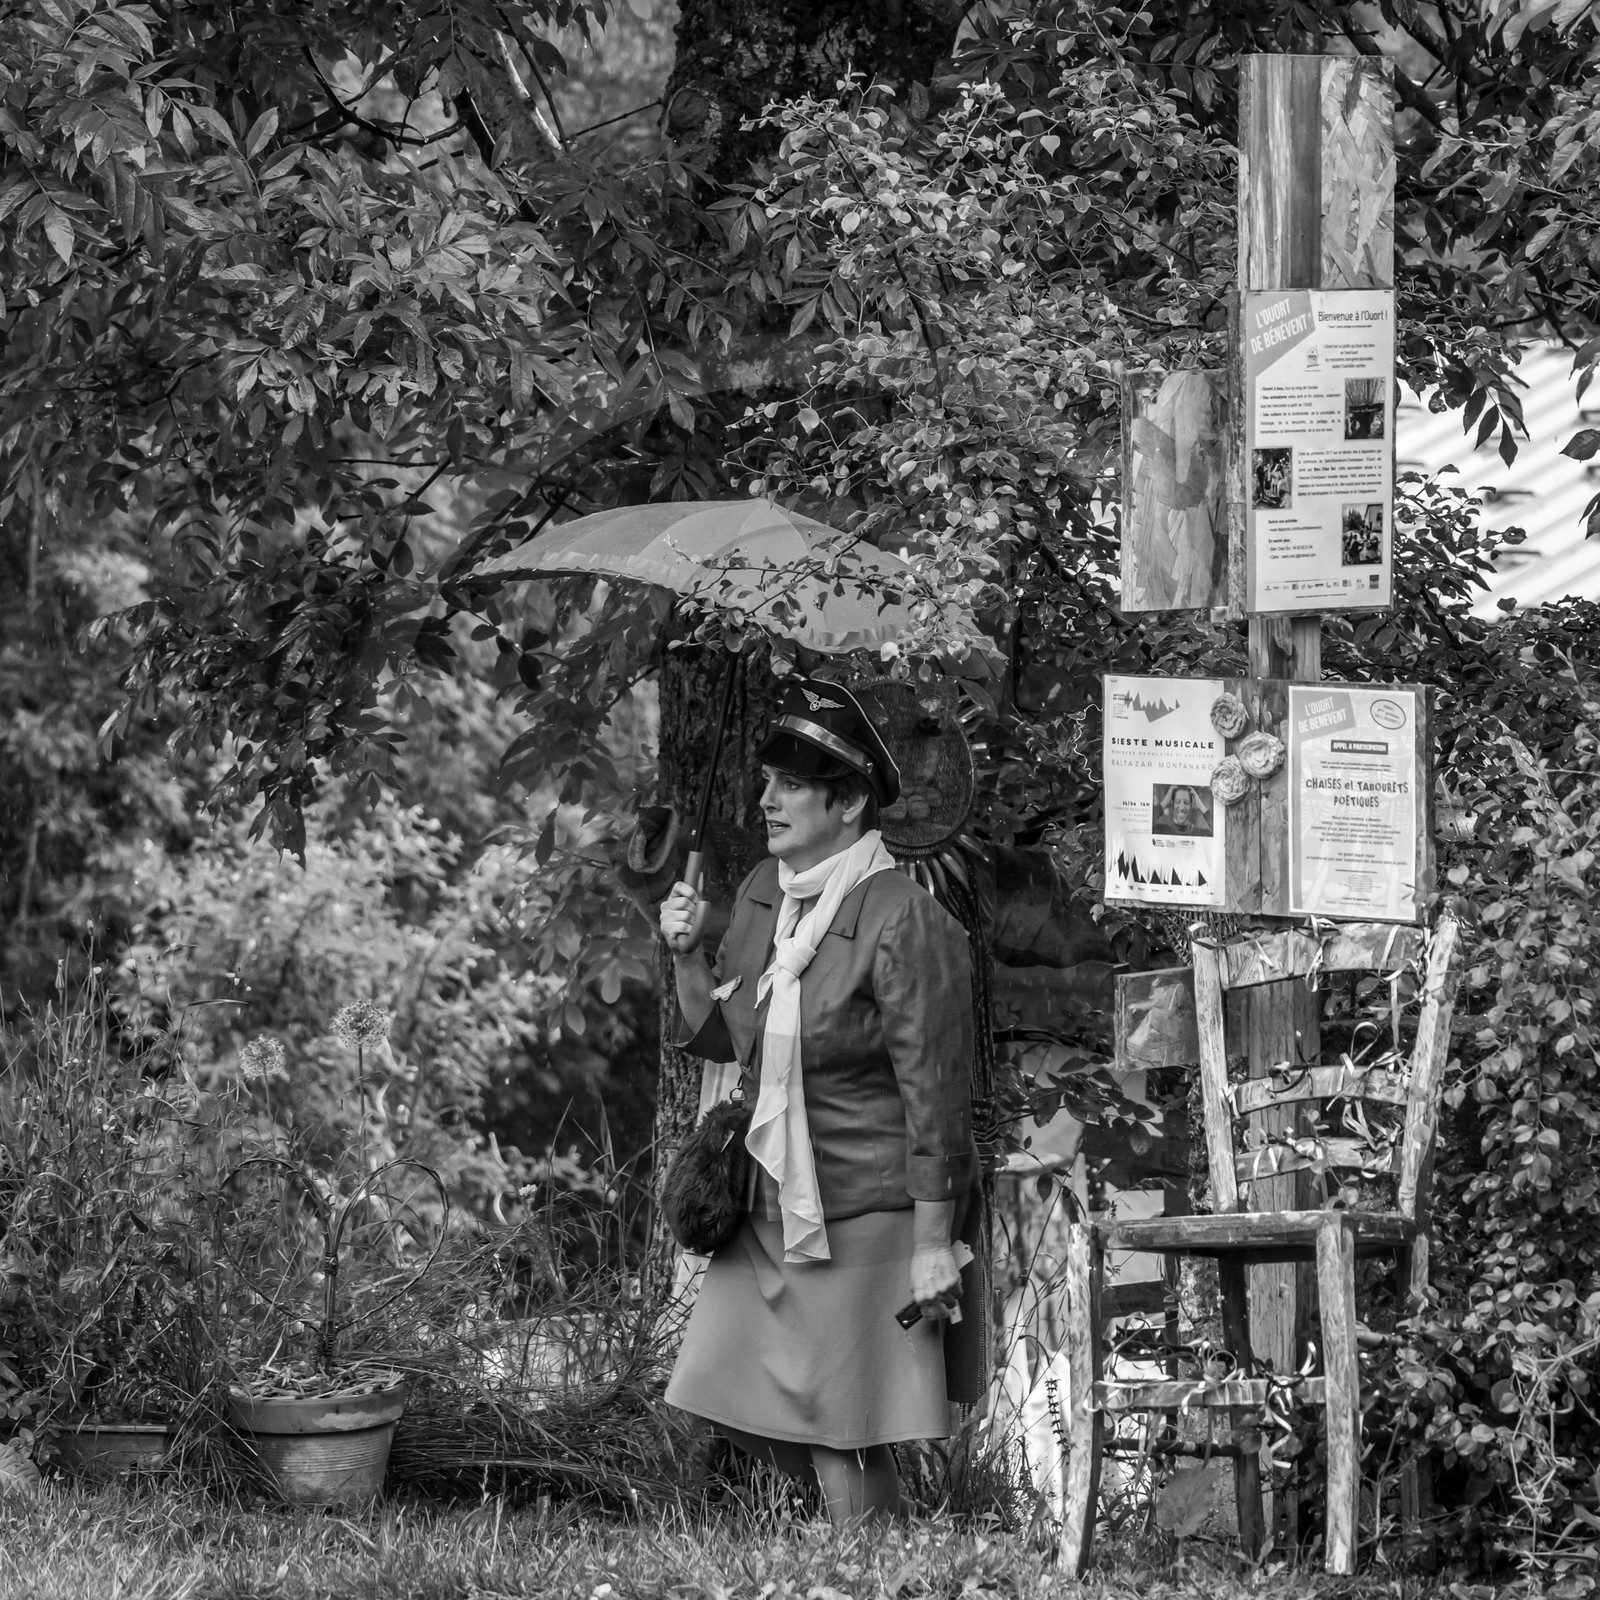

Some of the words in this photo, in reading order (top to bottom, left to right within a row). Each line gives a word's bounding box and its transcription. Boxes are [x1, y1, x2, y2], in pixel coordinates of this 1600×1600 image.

[1255, 298, 1290, 328] L'OUORT
[1318, 311, 1354, 322] Bienvenue
[1354, 310, 1360, 321] à
[1361, 310, 1384, 321] l'Ouort
[1250, 335, 1264, 354] DE
[1304, 697, 1334, 716] L'OUORT
[1298, 720, 1309, 733] DE
[1111, 737, 1148, 747] SIESTE
[1155, 739, 1215, 749] MUSICALE
[1111, 759, 1153, 768] BALTAZAR
[1158, 762, 1215, 771] MONTANARO
[1305, 777, 1342, 790] CHAISES
[1357, 781, 1409, 794] TABOURETS
